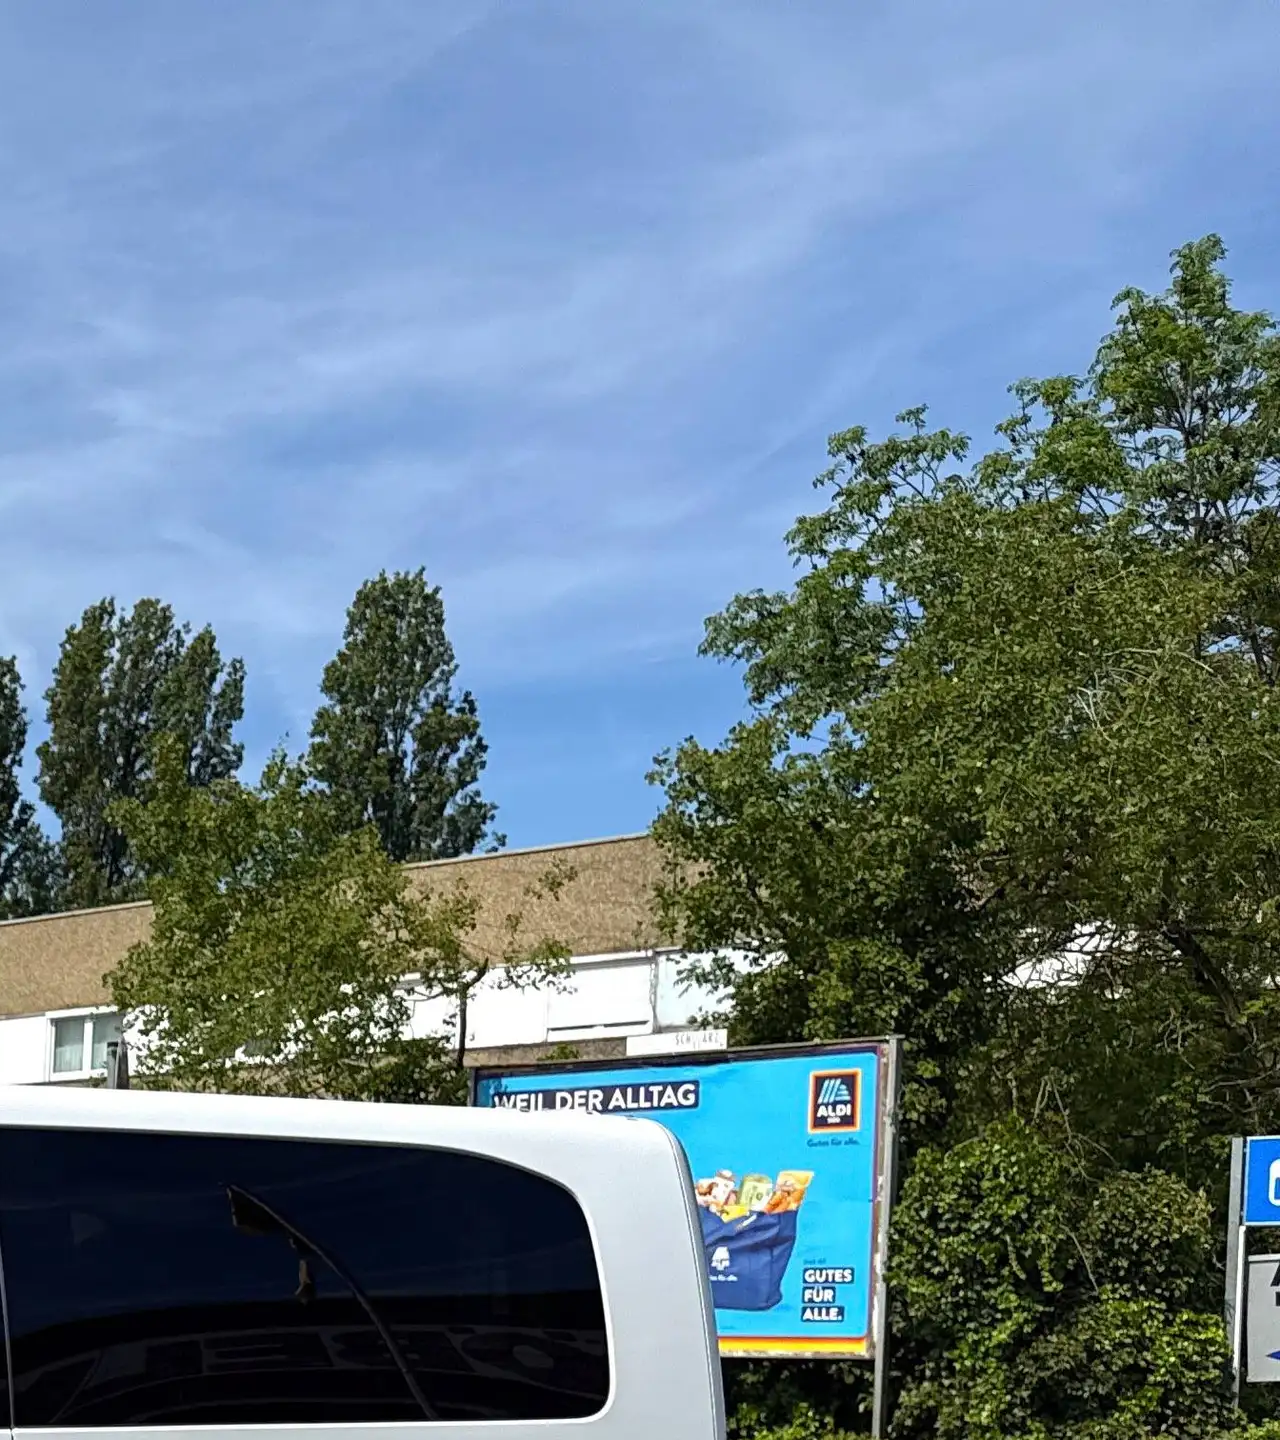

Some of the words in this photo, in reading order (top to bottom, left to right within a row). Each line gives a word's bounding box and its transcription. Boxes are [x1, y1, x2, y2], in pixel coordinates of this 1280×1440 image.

[554, 1089, 605, 1112] DER
[608, 1083, 697, 1110] ALLTAG
[816, 1103, 852, 1118] ALDI
[804, 1268, 853, 1283] GUTES
[803, 1286, 834, 1303] FÜR
[802, 1307, 842, 1321] ALLE.
